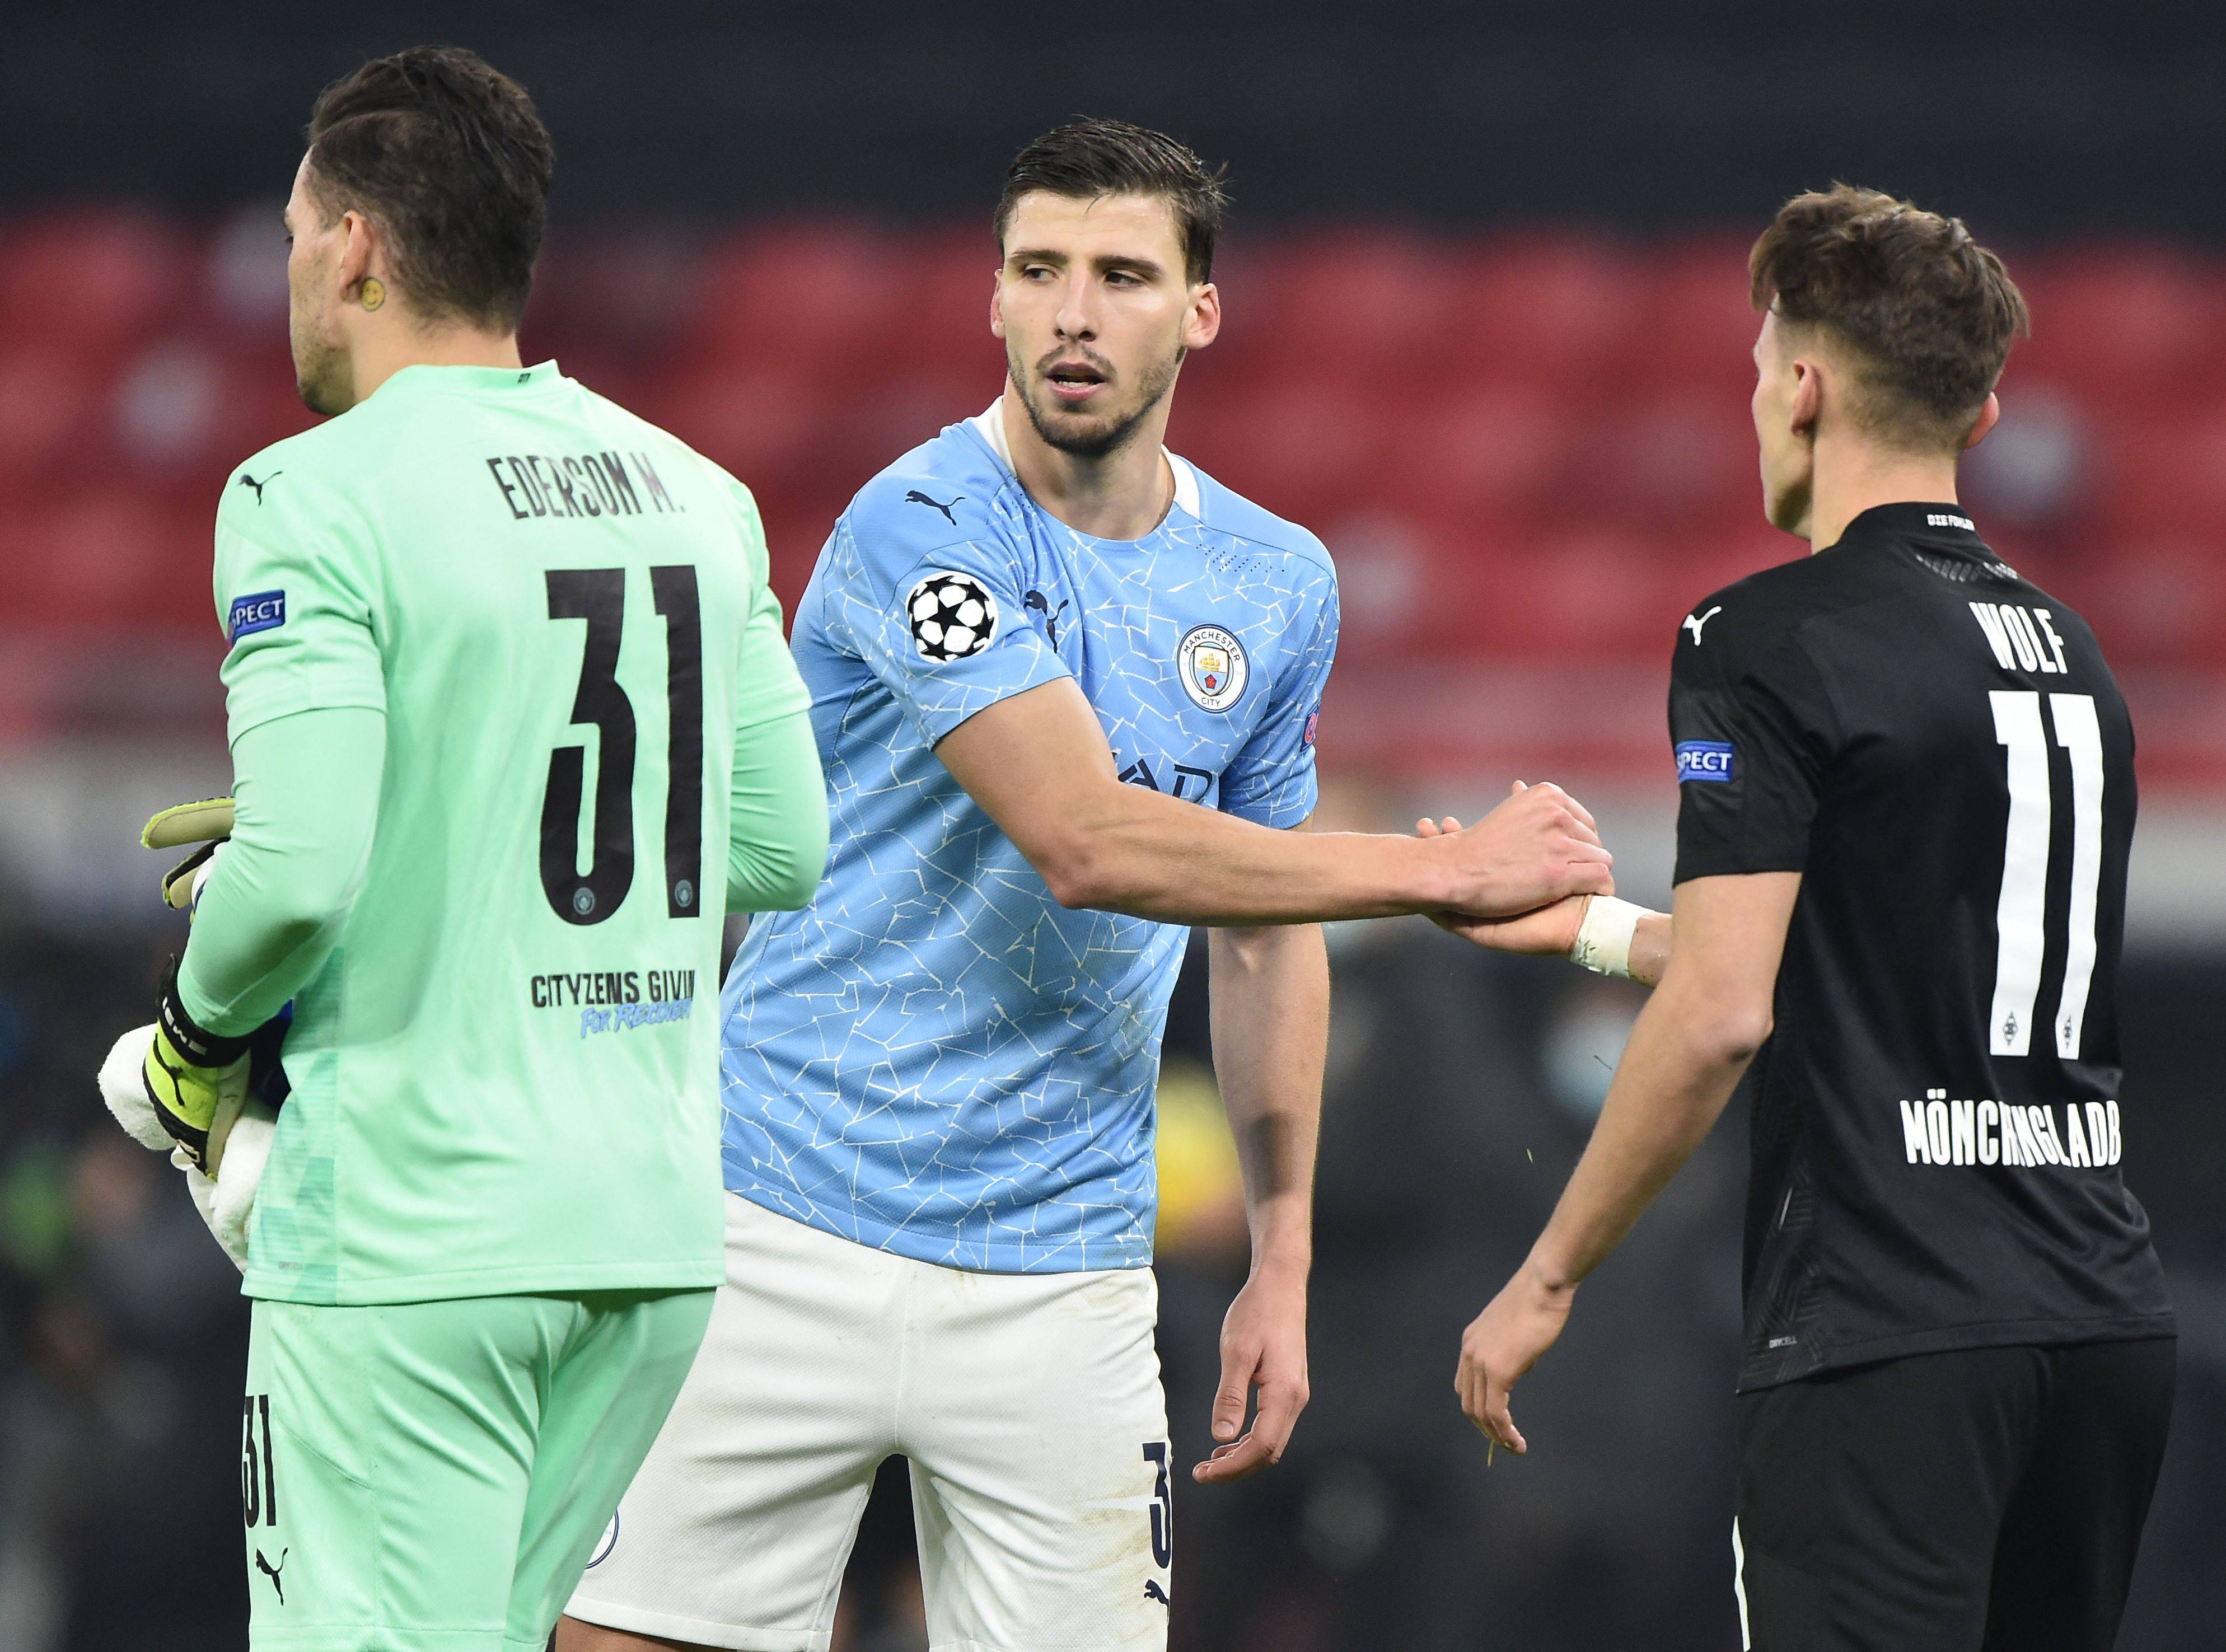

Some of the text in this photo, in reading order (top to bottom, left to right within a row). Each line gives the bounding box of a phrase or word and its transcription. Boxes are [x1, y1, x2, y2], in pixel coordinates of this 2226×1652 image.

[487, 451, 642, 519] EDERSON
[1184, 631, 1240, 662] MANCHESTER
[1968, 602, 2068, 674] WOLF
[1201, 697, 1220, 707] CITY
[539, 565, 703, 925] 31
[1112, 752, 1213, 803] AD
[1988, 690, 2104, 1060] 11
[532, 971, 640, 1008] CITYZENS
[1900, 1088, 2122, 1168] MÖNCHNGLADB
[244, 1394, 277, 1528] 31
[1143, 1442, 1171, 1569] 3
